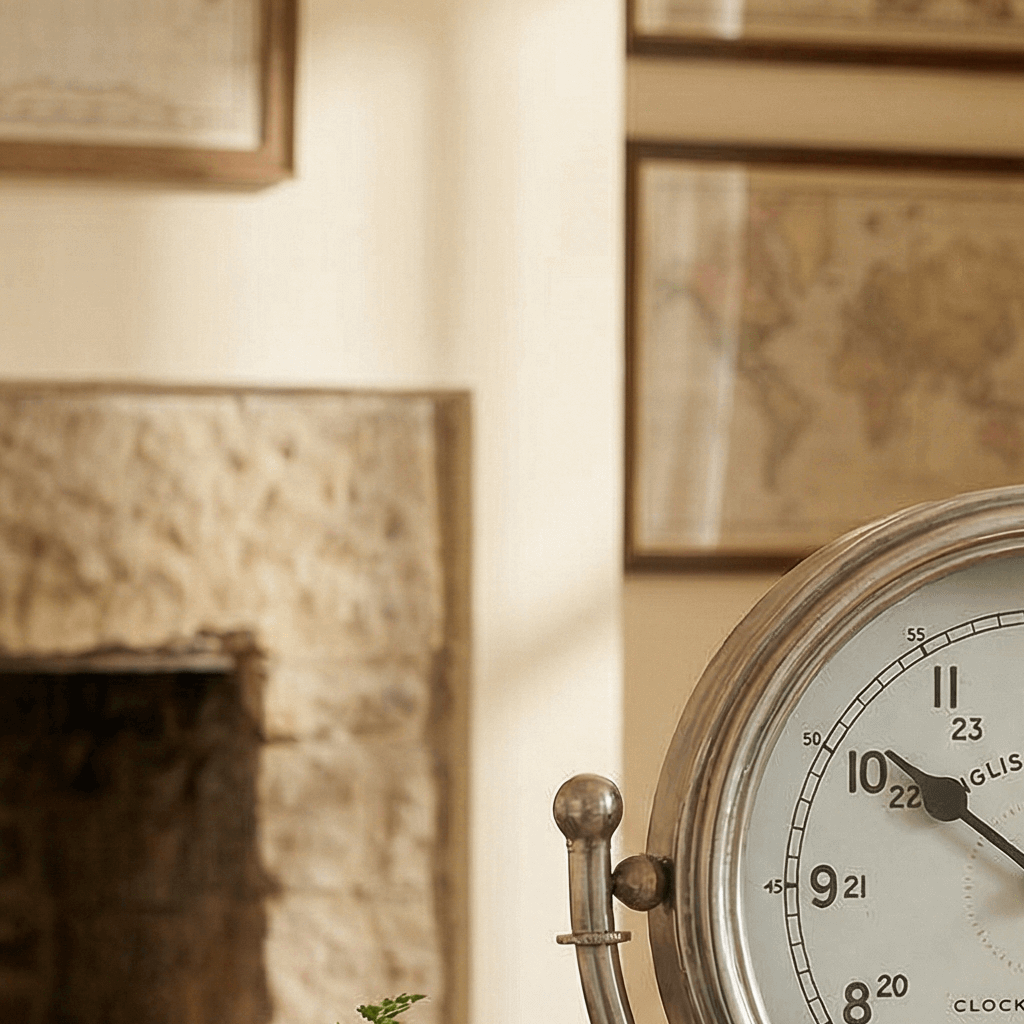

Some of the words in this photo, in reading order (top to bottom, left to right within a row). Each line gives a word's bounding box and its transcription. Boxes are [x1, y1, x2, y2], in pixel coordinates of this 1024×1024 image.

[906, 628, 926, 641] 55
[934, 666, 957, 709] 11
[803, 732, 821, 746] 50
[952, 718, 982, 740] 23
[849, 750, 887, 794] 10
[889, 785, 922, 808] 22
[810, 865, 837, 908] 9
[844, 875, 865, 898] 21
[877, 974, 908, 997] 20
